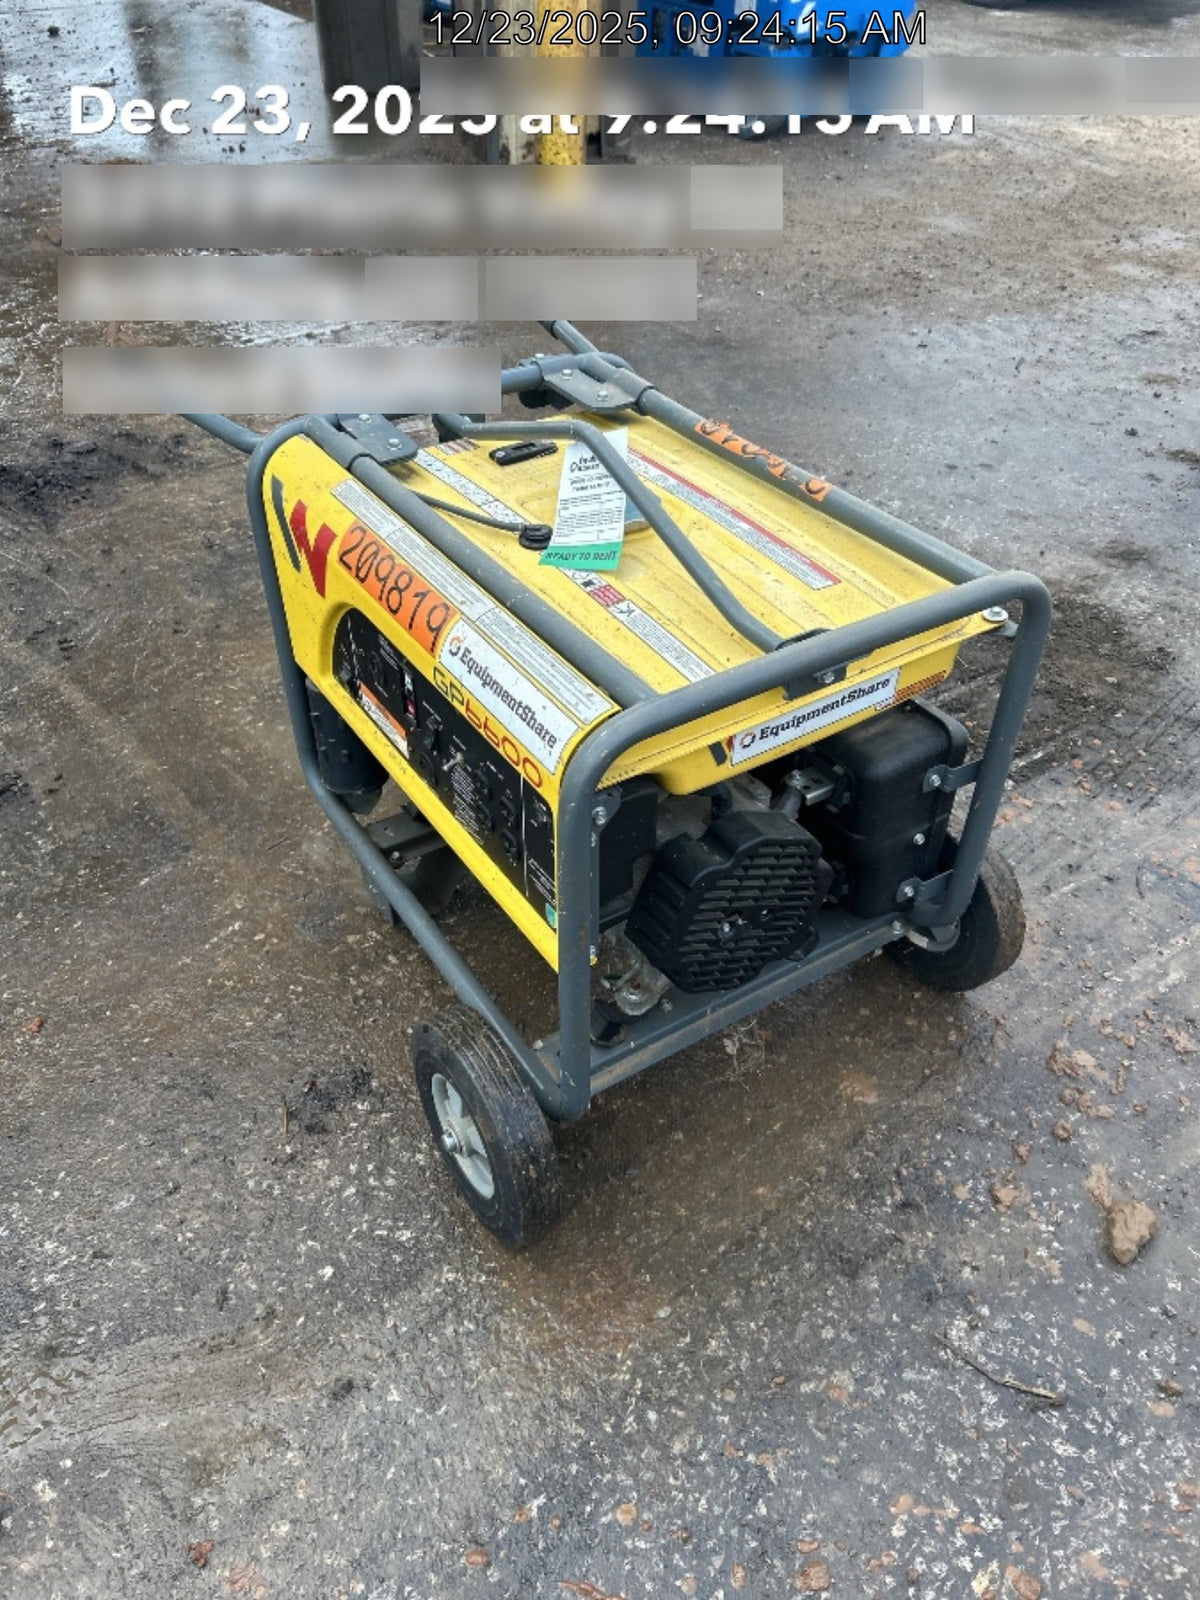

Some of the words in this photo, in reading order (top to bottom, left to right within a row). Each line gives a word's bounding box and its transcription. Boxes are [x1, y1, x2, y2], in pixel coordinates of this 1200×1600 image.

[339, 525, 452, 653] 209819
[593, 550, 619, 561] RENT
[460, 645, 557, 749] EquipmentShare
[758, 678, 890, 741] EquipmentShare
